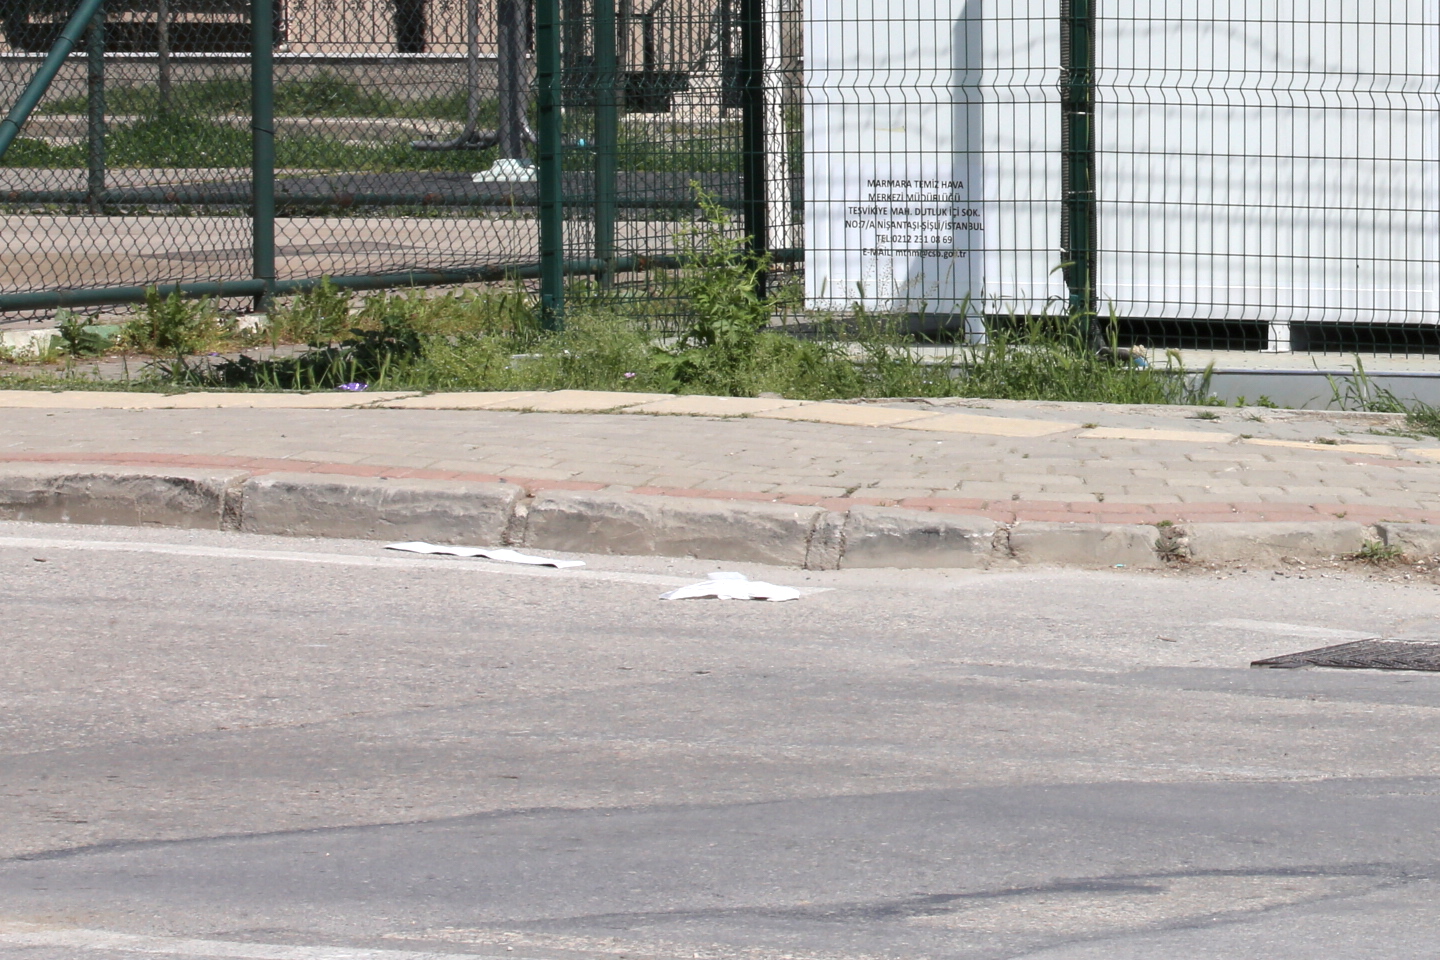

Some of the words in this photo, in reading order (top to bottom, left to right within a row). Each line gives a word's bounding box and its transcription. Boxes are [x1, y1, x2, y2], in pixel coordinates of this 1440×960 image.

[867, 179, 912, 189] MARMARA
[914, 178, 939, 189] TEMİZ
[941, 180, 964, 189] HAVA
[931, 235, 940, 243] 08
[943, 235, 953, 243] 69
